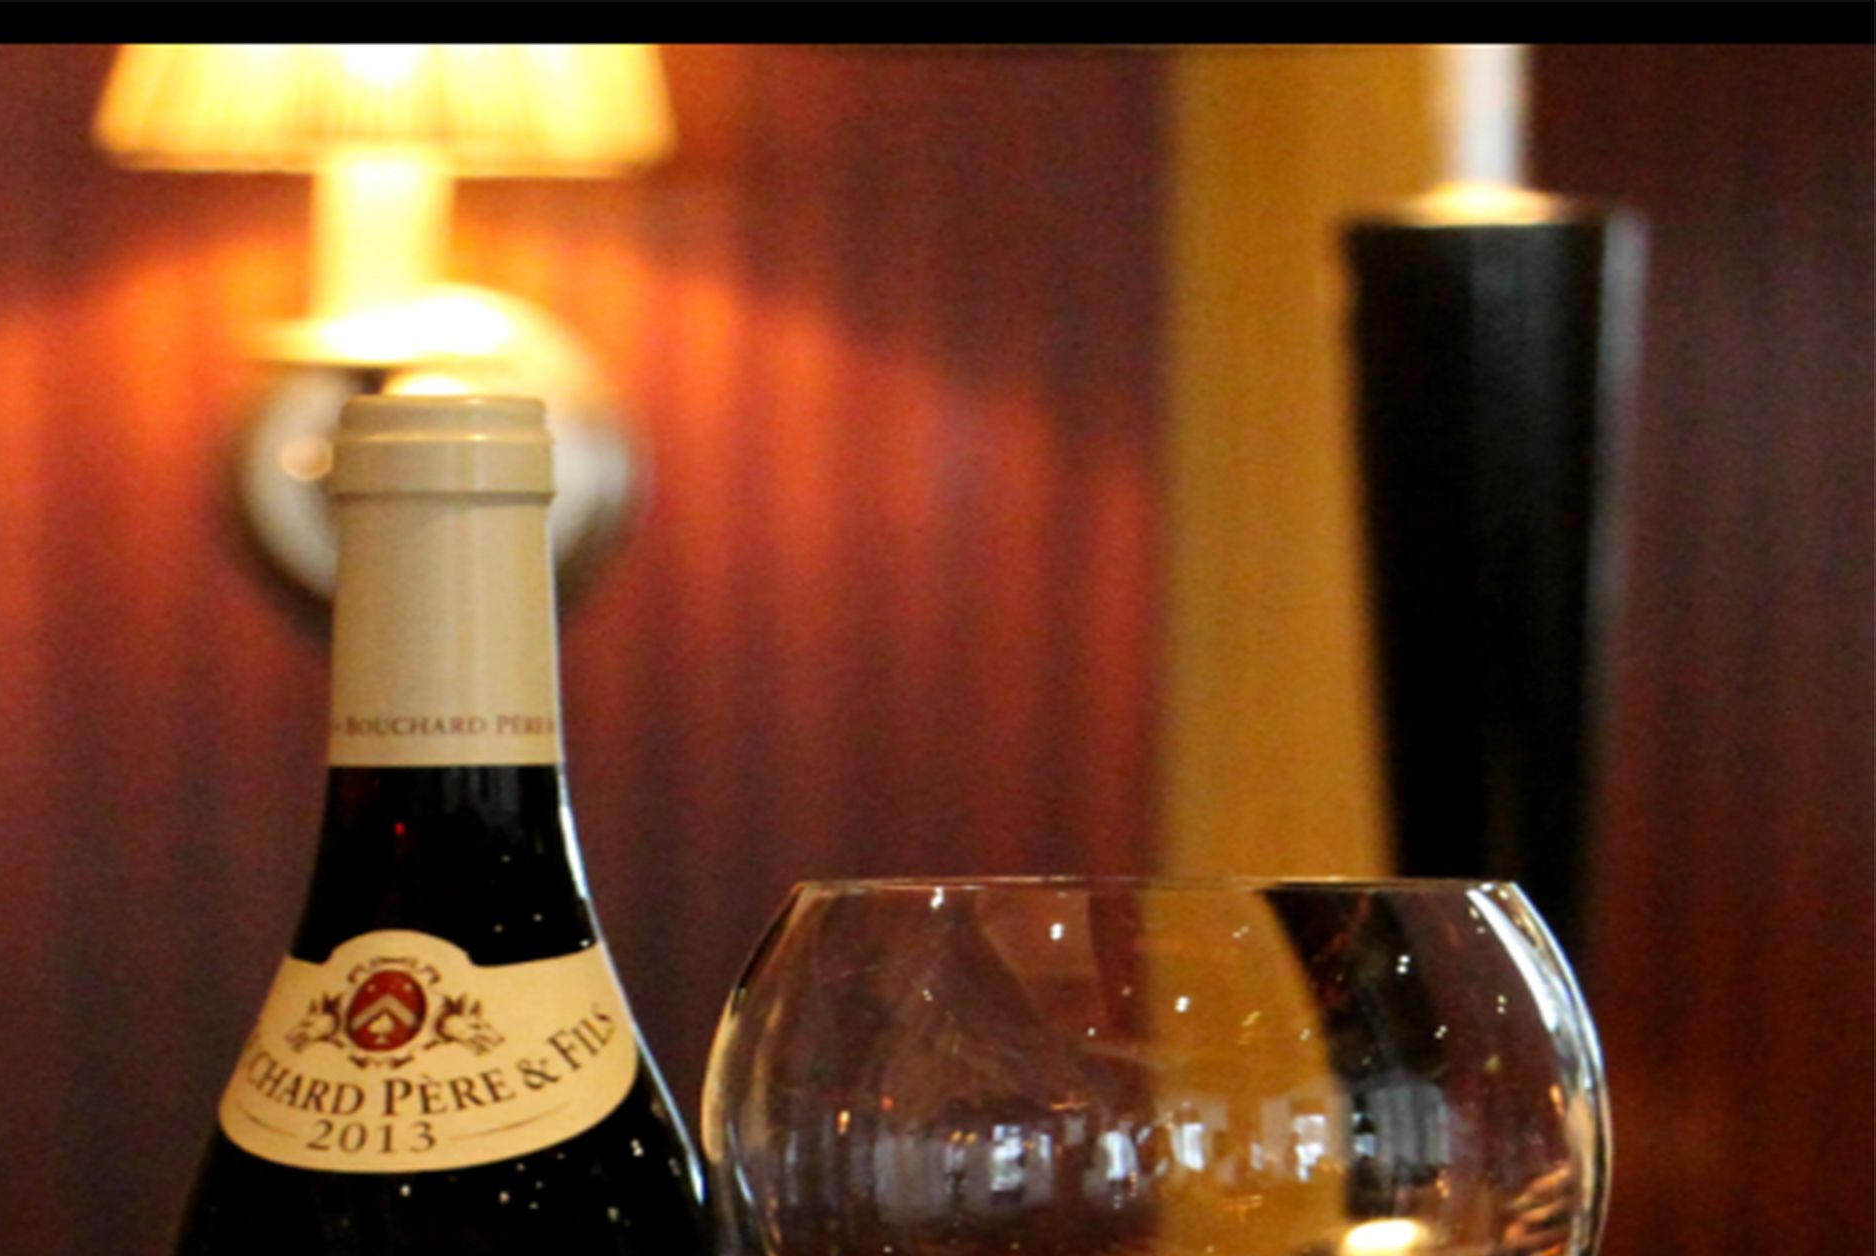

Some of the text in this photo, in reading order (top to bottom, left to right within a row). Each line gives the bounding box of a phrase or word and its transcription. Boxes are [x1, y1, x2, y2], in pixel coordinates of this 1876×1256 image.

[344, 714, 488, 737] BOUCHARD
[382, 1072, 516, 1117] PÈRE
[515, 1057, 560, 1091] &
[546, 1003, 618, 1071] FILS
[306, 1120, 437, 1154] 2013
